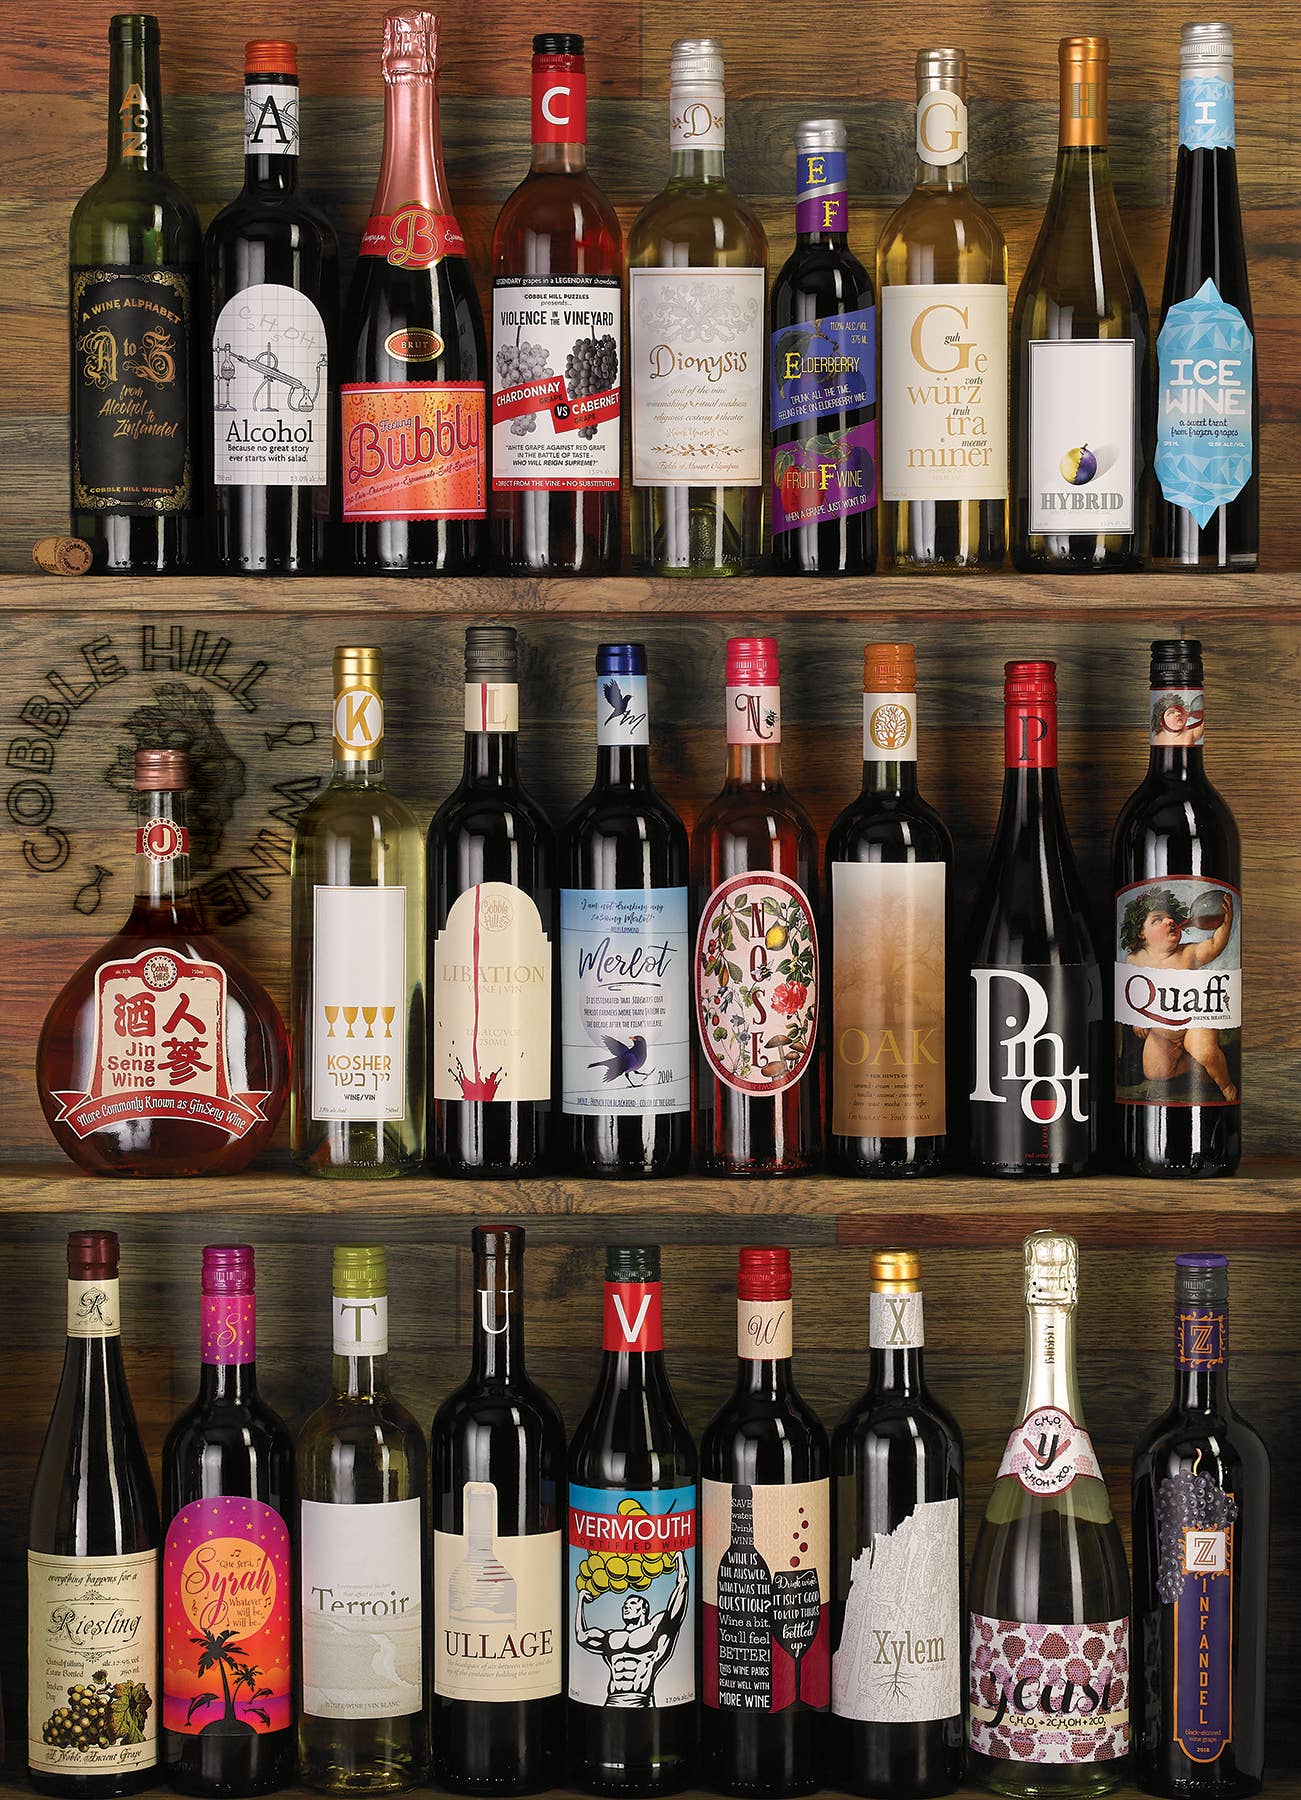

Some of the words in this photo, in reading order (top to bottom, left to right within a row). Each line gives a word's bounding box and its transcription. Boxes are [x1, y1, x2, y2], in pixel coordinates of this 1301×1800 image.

[119, 83, 151, 114] A
[541, 86, 571, 125] C
[1070, 82, 1099, 119] H
[250, 95, 291, 144] A
[683, 103, 712, 139] D
[1193, 101, 1217, 124] I
[919, 102, 963, 153] G
[122, 131, 148, 158] Z
[805, 156, 827, 185] E
[822, 200, 840, 228] F
[386, 209, 439, 266] B
[82, 311, 91, 324] A
[90, 298, 121, 317] WINE
[123, 298, 181, 325] ALPHABET
[500, 310, 547, 326] VIOLENCE
[563, 310, 614, 326] VINEYARD
[123, 337, 137, 358] to
[401, 341, 429, 349] BRUT
[943, 332, 961, 345] guh
[649, 344, 748, 382] Dionysis
[783, 352, 860, 379] ELDERBERRY
[1169, 359, 1242, 387] ICE
[119, 383, 143, 399] from
[666, 385, 688, 397] god
[824, 387, 835, 397] THE
[907, 376, 982, 405] würz
[964, 374, 984, 385] vorts
[496, 381, 561, 407] CHARDONNAY
[571, 392, 620, 415] CABERNET
[1165, 388, 1246, 416] WINE
[99, 398, 146, 419] Alcohol
[556, 406, 568, 417] VS
[653, 412, 685, 424] religious
[719, 411, 744, 421] theater
[113, 418, 180, 440] Zinfandel
[225, 419, 315, 444] Alcohol
[945, 411, 988, 436] tra
[1208, 417, 1228, 427] treat
[227, 443, 256, 452] Because
[269, 444, 290, 454] great
[291, 444, 310, 454] story
[348, 403, 481, 486] Bubbly
[907, 437, 993, 468] miner
[961, 440, 988, 448] meener
[244, 454, 267, 462] starts
[268, 454, 286, 462] with
[786, 471, 817, 489] FRUIT
[818, 463, 837, 491] F
[836, 469, 863, 488] WINE
[785, 511, 800, 522] WHEN
[805, 504, 826, 518] GRAPE
[827, 501, 841, 513] JUST
[1040, 492, 1124, 510] HYBRID
[346, 694, 372, 741] K
[734, 692, 774, 740] N
[5, 634, 129, 872] COBBLE
[142, 625, 269, 714] HILL
[1017, 715, 1048, 761] P
[152, 827, 172, 852] J
[578, 936, 678, 983] Merlot
[749, 902, 769, 1068] NOSE
[1124, 974, 1230, 1026] Quaff
[113, 991, 156, 1037] 酒
[125, 1042, 155, 1057] Jin
[839, 1027, 940, 1066] OAK
[969, 968, 1089, 1124] Pinot
[107, 1055, 156, 1072] Seng
[327, 1054, 392, 1071] KOSHER
[112, 1072, 156, 1087] Wine
[76, 1111, 101, 1127] More
[101, 1099, 144, 1117] Commonly
[145, 1098, 175, 1110] Known
[177, 1100, 187, 1110] as
[187, 1099, 225, 1122] GinSeng
[226, 1111, 247, 1130] Wine
[79, 1286, 114, 1328] R
[477, 1289, 514, 1334] U
[612, 1293, 652, 1343] V
[210, 1312, 241, 1347] S
[339, 1303, 378, 1342] T
[747, 1310, 786, 1347] W
[885, 1298, 913, 1346] X
[1190, 1324, 1213, 1355] Z
[731, 1498, 753, 1509] SAVE
[731, 1512, 753, 1520] water
[574, 1512, 691, 1541] VERMOUTH
[731, 1522, 753, 1533] Drink
[731, 1536, 754, 1546] WINE
[727, 1552, 748, 1565] WINE
[750, 1552, 758, 1565] IS
[85, 1572, 118, 1586] happens
[117, 1570, 132, 1585] for
[720, 1566, 732, 1579] THE
[733, 1568, 768, 1581] ANSWER.
[182, 1547, 273, 1629] Syrah
[719, 1581, 740, 1594] WHAT
[741, 1582, 755, 1595] WAS
[757, 1583, 771, 1595] THE
[773, 1594, 781, 1606] IT
[311, 1586, 410, 1616] Terroir
[719, 1595, 772, 1613] QUESTION?
[773, 1610, 783, 1620] TO
[801, 1605, 820, 1618] THINGS
[47, 1605, 142, 1645] Riesling
[719, 1612, 744, 1627] Wine
[745, 1620, 753, 1628] a
[782, 1619, 814, 1639] bottled
[443, 1629, 554, 1660] ULLAGE
[719, 1628, 747, 1644] You'll
[748, 1631, 771, 1645] feel
[872, 1629, 946, 1668] Xylem
[719, 1645, 771, 1662] BETTER!
[719, 1662, 732, 1676] THIS
[732, 1665, 749, 1676] WINE
[751, 1666, 770, 1676] PAIRS
[736, 1680, 752, 1690] WELL
[753, 1681, 770, 1690] WITH
[719, 1691, 742, 1707] MORE
[744, 1694, 771, 1708] WINE
[119, 1748, 142, 1763] Grape
